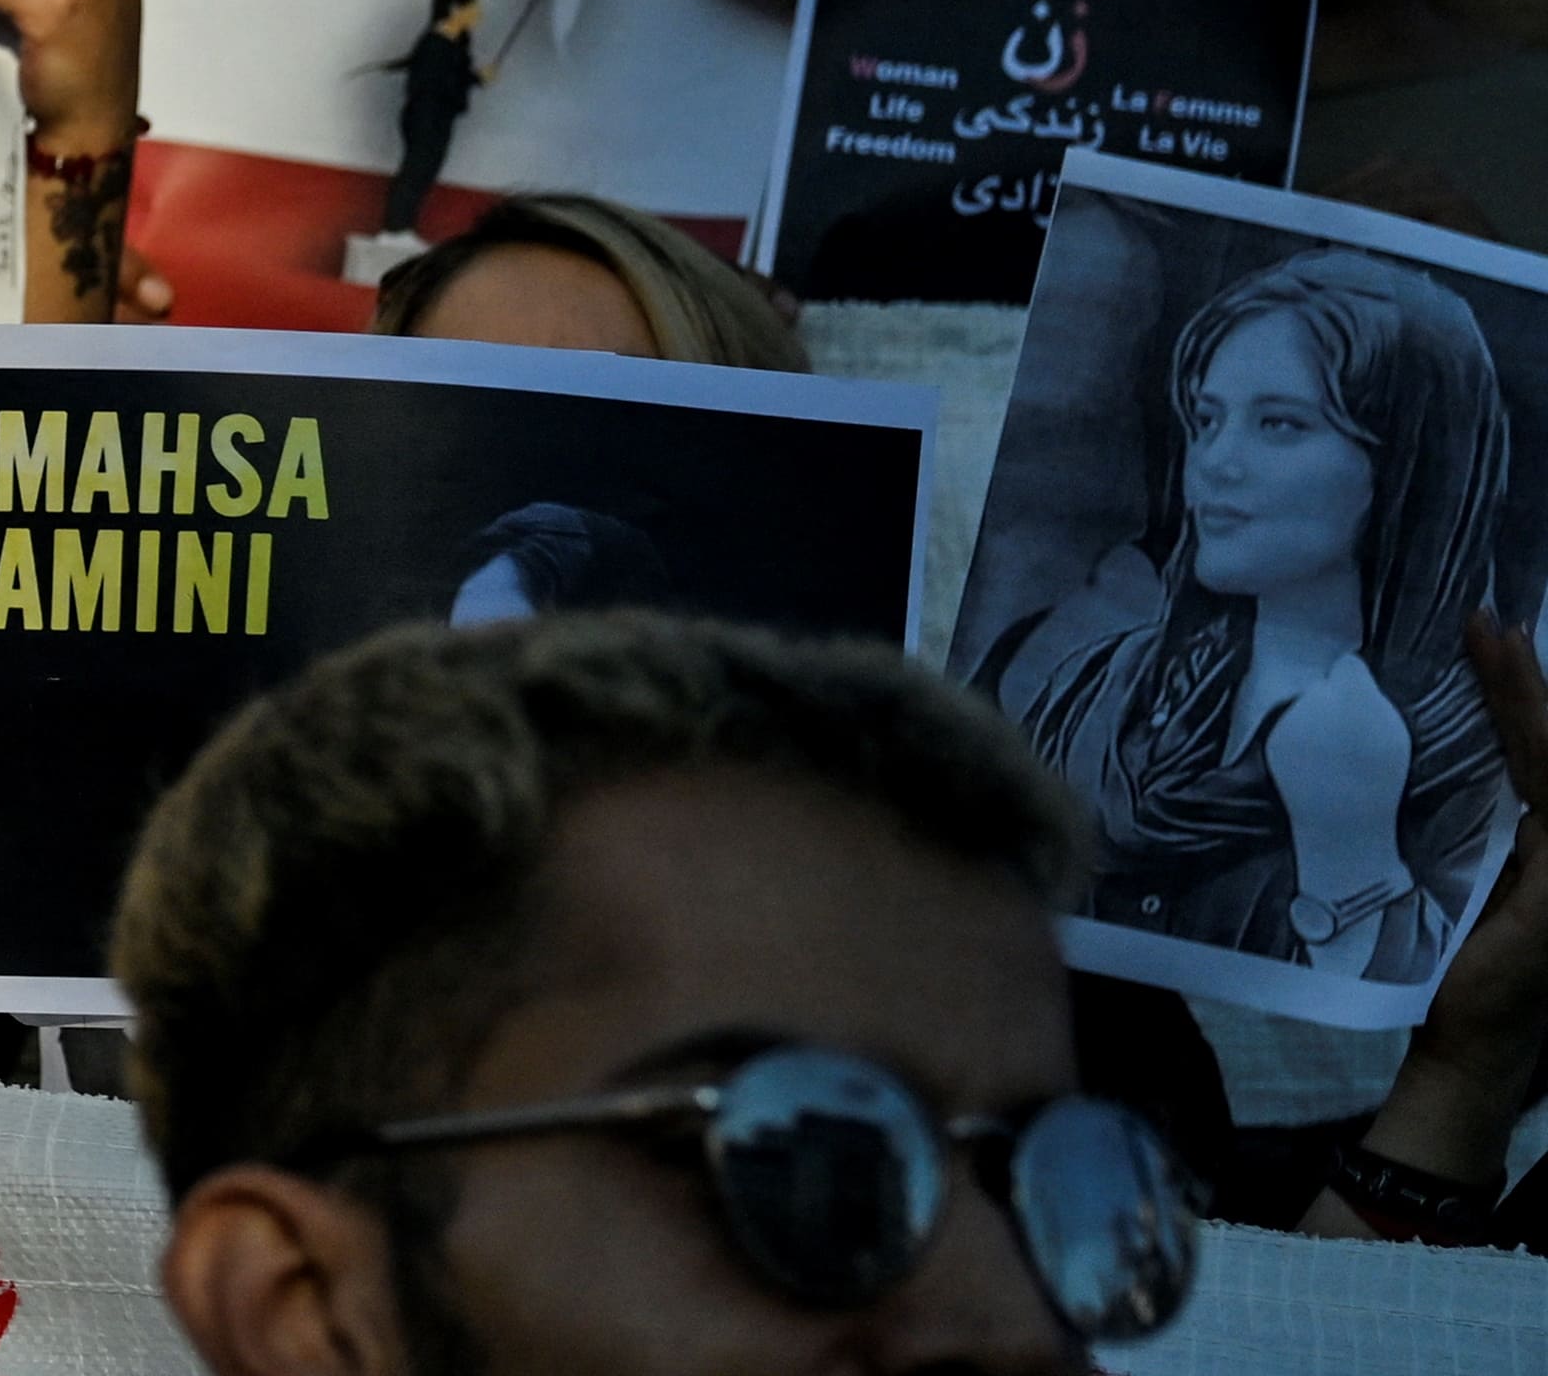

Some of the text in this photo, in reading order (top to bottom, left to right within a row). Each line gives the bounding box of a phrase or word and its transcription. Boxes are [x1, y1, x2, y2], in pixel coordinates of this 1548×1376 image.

[850, 55, 958, 90] Woman
[869, 94, 925, 122] Life
[1112, 84, 1262, 126] La Femme
[826, 127, 956, 162] Freedom
[1139, 125, 1229, 159] La Vie
